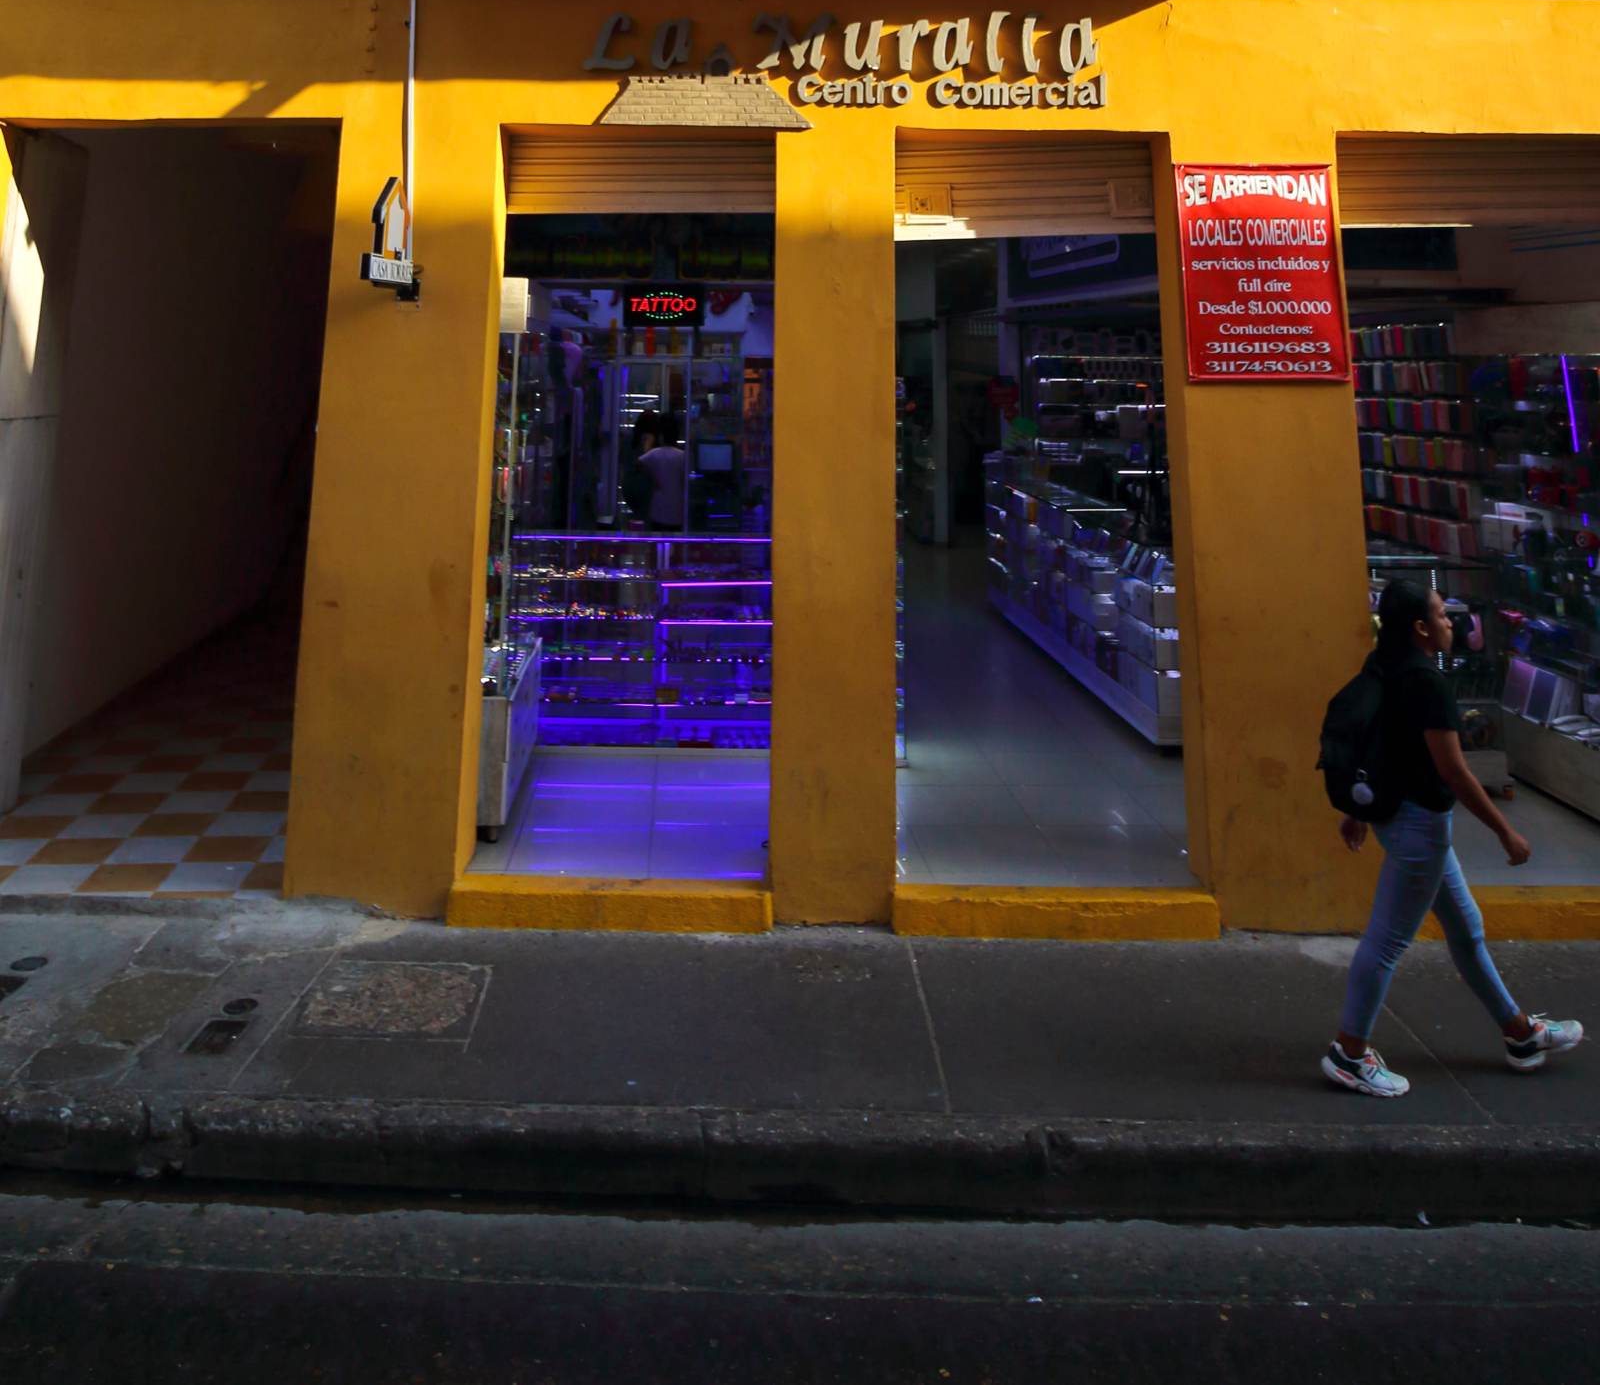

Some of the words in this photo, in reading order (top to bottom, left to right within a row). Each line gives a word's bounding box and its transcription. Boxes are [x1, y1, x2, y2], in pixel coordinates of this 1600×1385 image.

[584, 11, 691, 71] La
[752, 10, 1099, 74] Muralla
[796, 75, 912, 105] Centro
[934, 75, 1107, 107] Comercial
[1183, 174, 1208, 206] SE
[1211, 174, 1327, 206] ARRIENDAN
[1188, 219, 1243, 246] LOCALES
[1246, 218, 1327, 246] COMERCIALES
[1191, 257, 1254, 271] servicios
[1257, 256, 1320, 271] incluidos
[1322, 259, 1330, 273] y
[1238, 278, 1262, 293] full
[1263, 279, 1292, 293] aire
[629, 297, 697, 312] TATTOO
[1199, 300, 1245, 315] Desde
[1248, 300, 1332, 315] $1.000.000
[1219, 323, 1313, 335] Contactenos:
[1205, 341, 1331, 354] 3116119683
[1205, 360, 1332, 373] 3117450613
